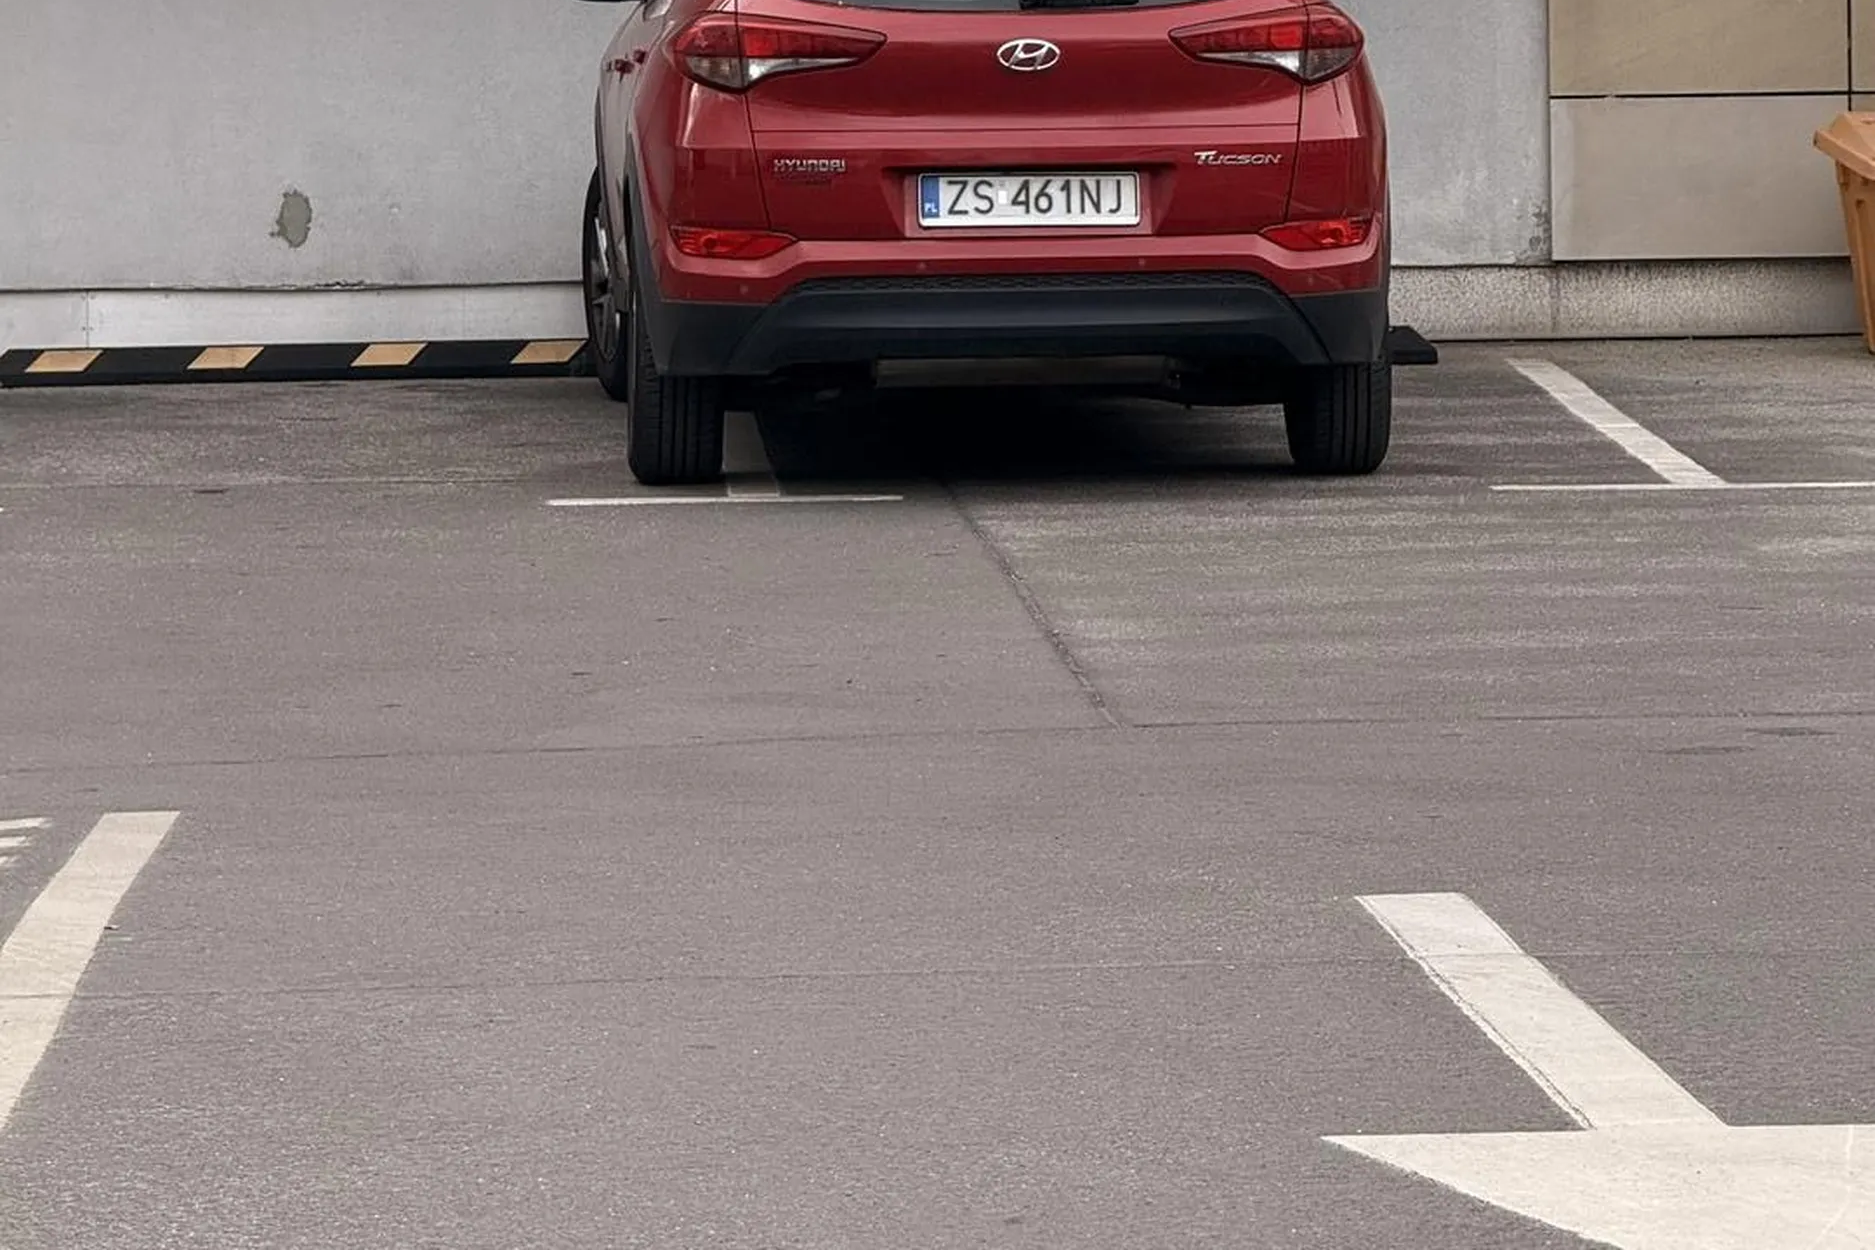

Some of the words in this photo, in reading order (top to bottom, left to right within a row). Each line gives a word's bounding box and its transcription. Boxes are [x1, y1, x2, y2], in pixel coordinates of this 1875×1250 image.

[1193, 150, 1283, 165] TUCSON
[773, 158, 846, 172] HYUNDAI
[946, 179, 994, 215] ZS
[1011, 178, 1122, 215] 461NJ
[923, 202, 939, 213] PL
